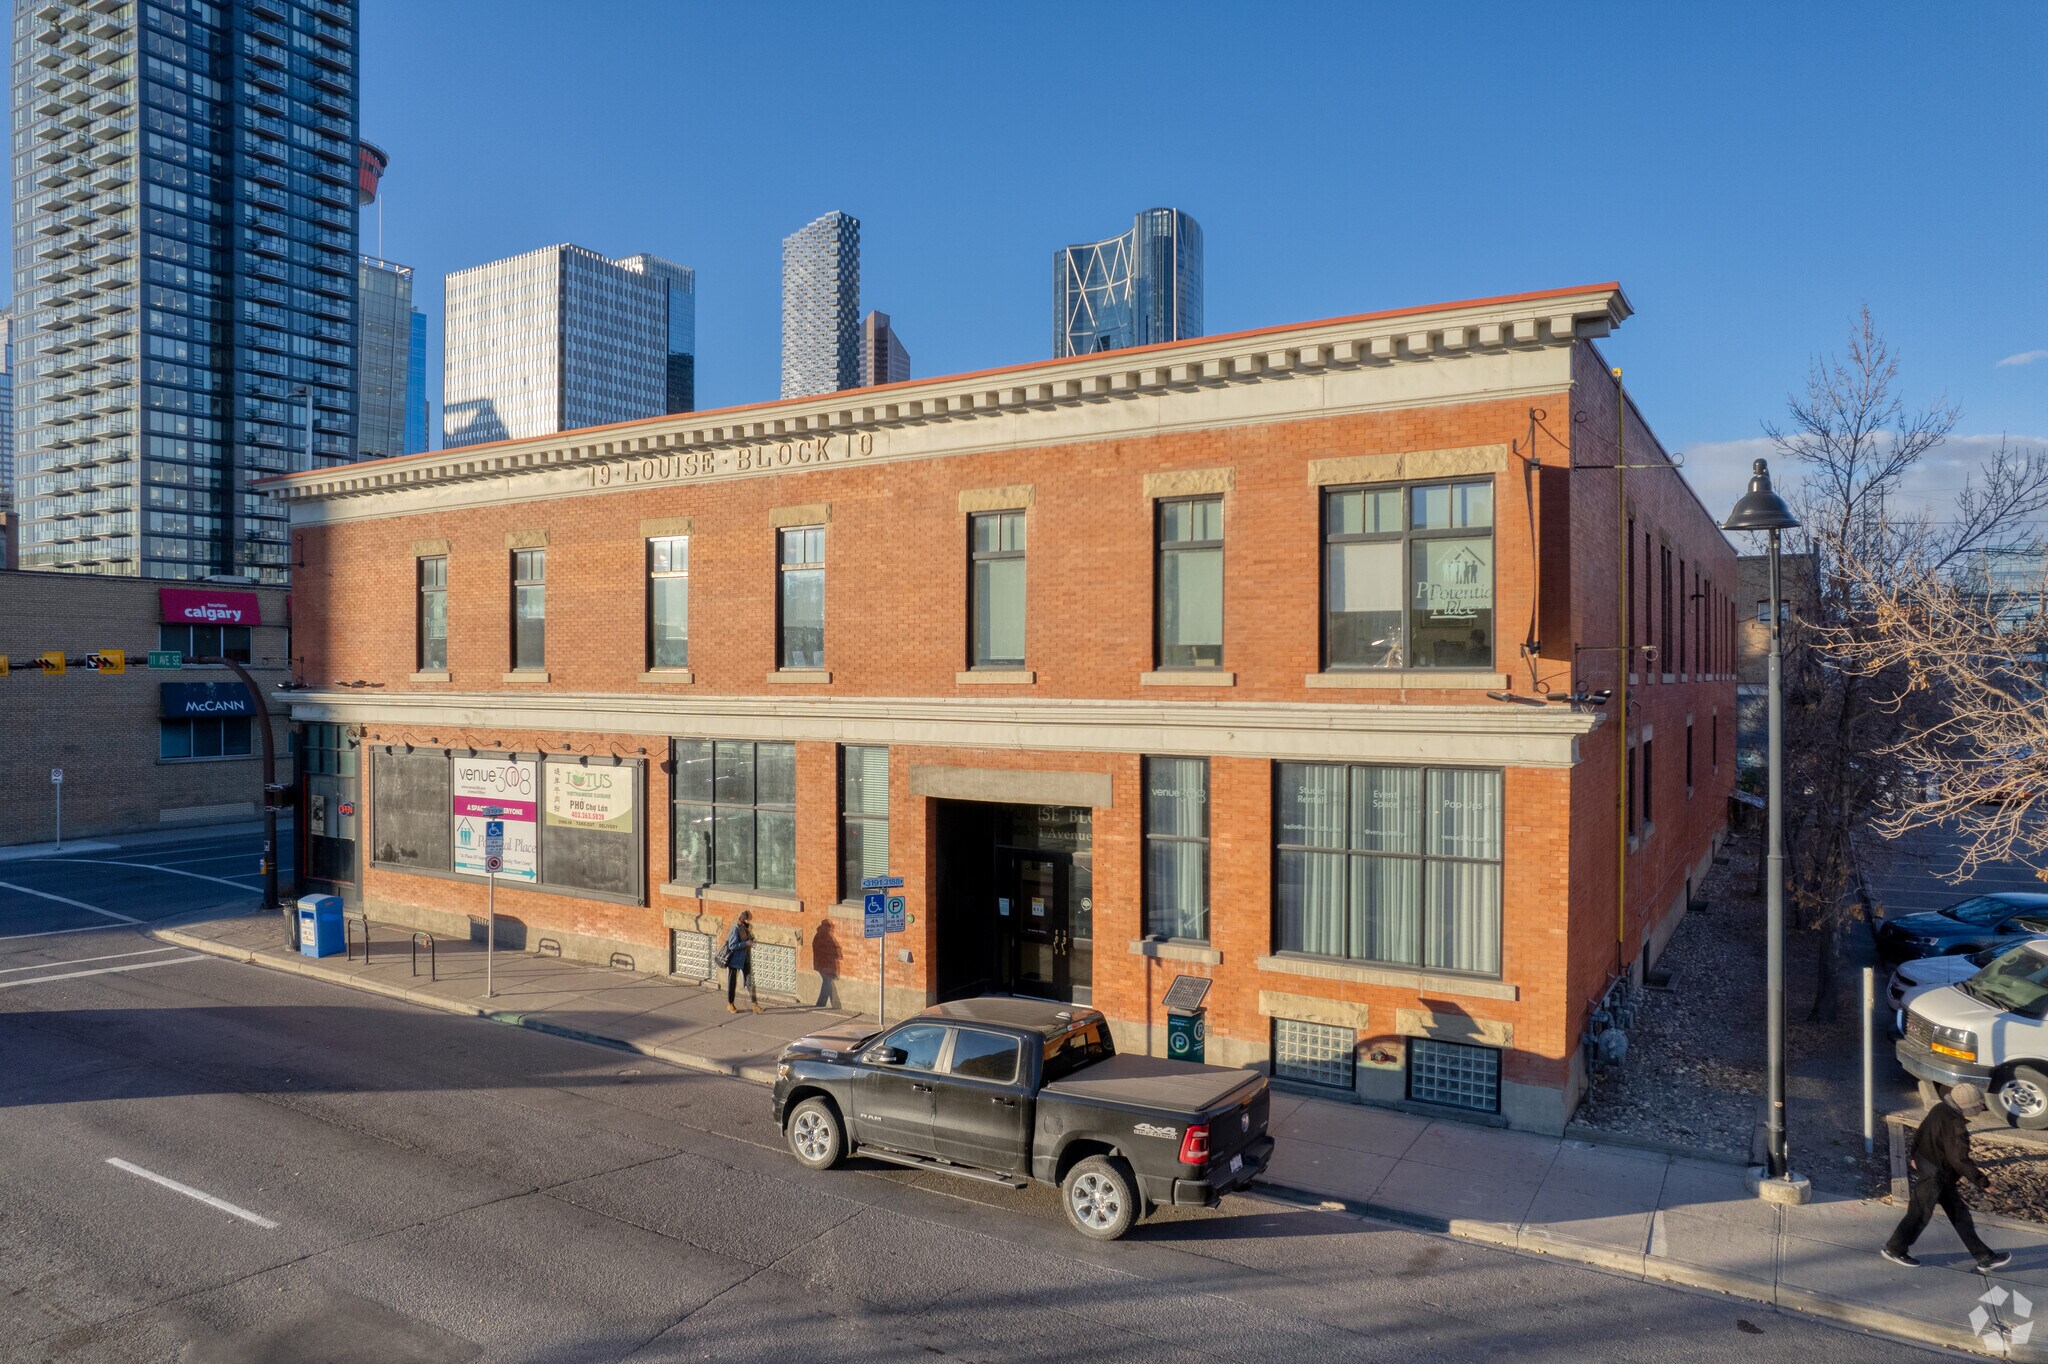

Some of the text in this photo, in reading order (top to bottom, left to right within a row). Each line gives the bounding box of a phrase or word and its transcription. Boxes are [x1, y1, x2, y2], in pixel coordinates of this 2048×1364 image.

[624, 452, 715, 482] LOUISE
[736, 437, 830, 471] BLOCK
[845, 431, 873, 458] 10
[184, 606, 242, 622] calgary
[150, 655, 180, 666] 11 AVE SE
[185, 700, 245, 712] McCANN
[1373, 790, 1399, 799] Event
[338, 805, 353, 814] OPEN
[1373, 799, 1400, 809] Space
[1048, 829, 1092, 841] Avenue
[860, 1113, 882, 1122] RAM
